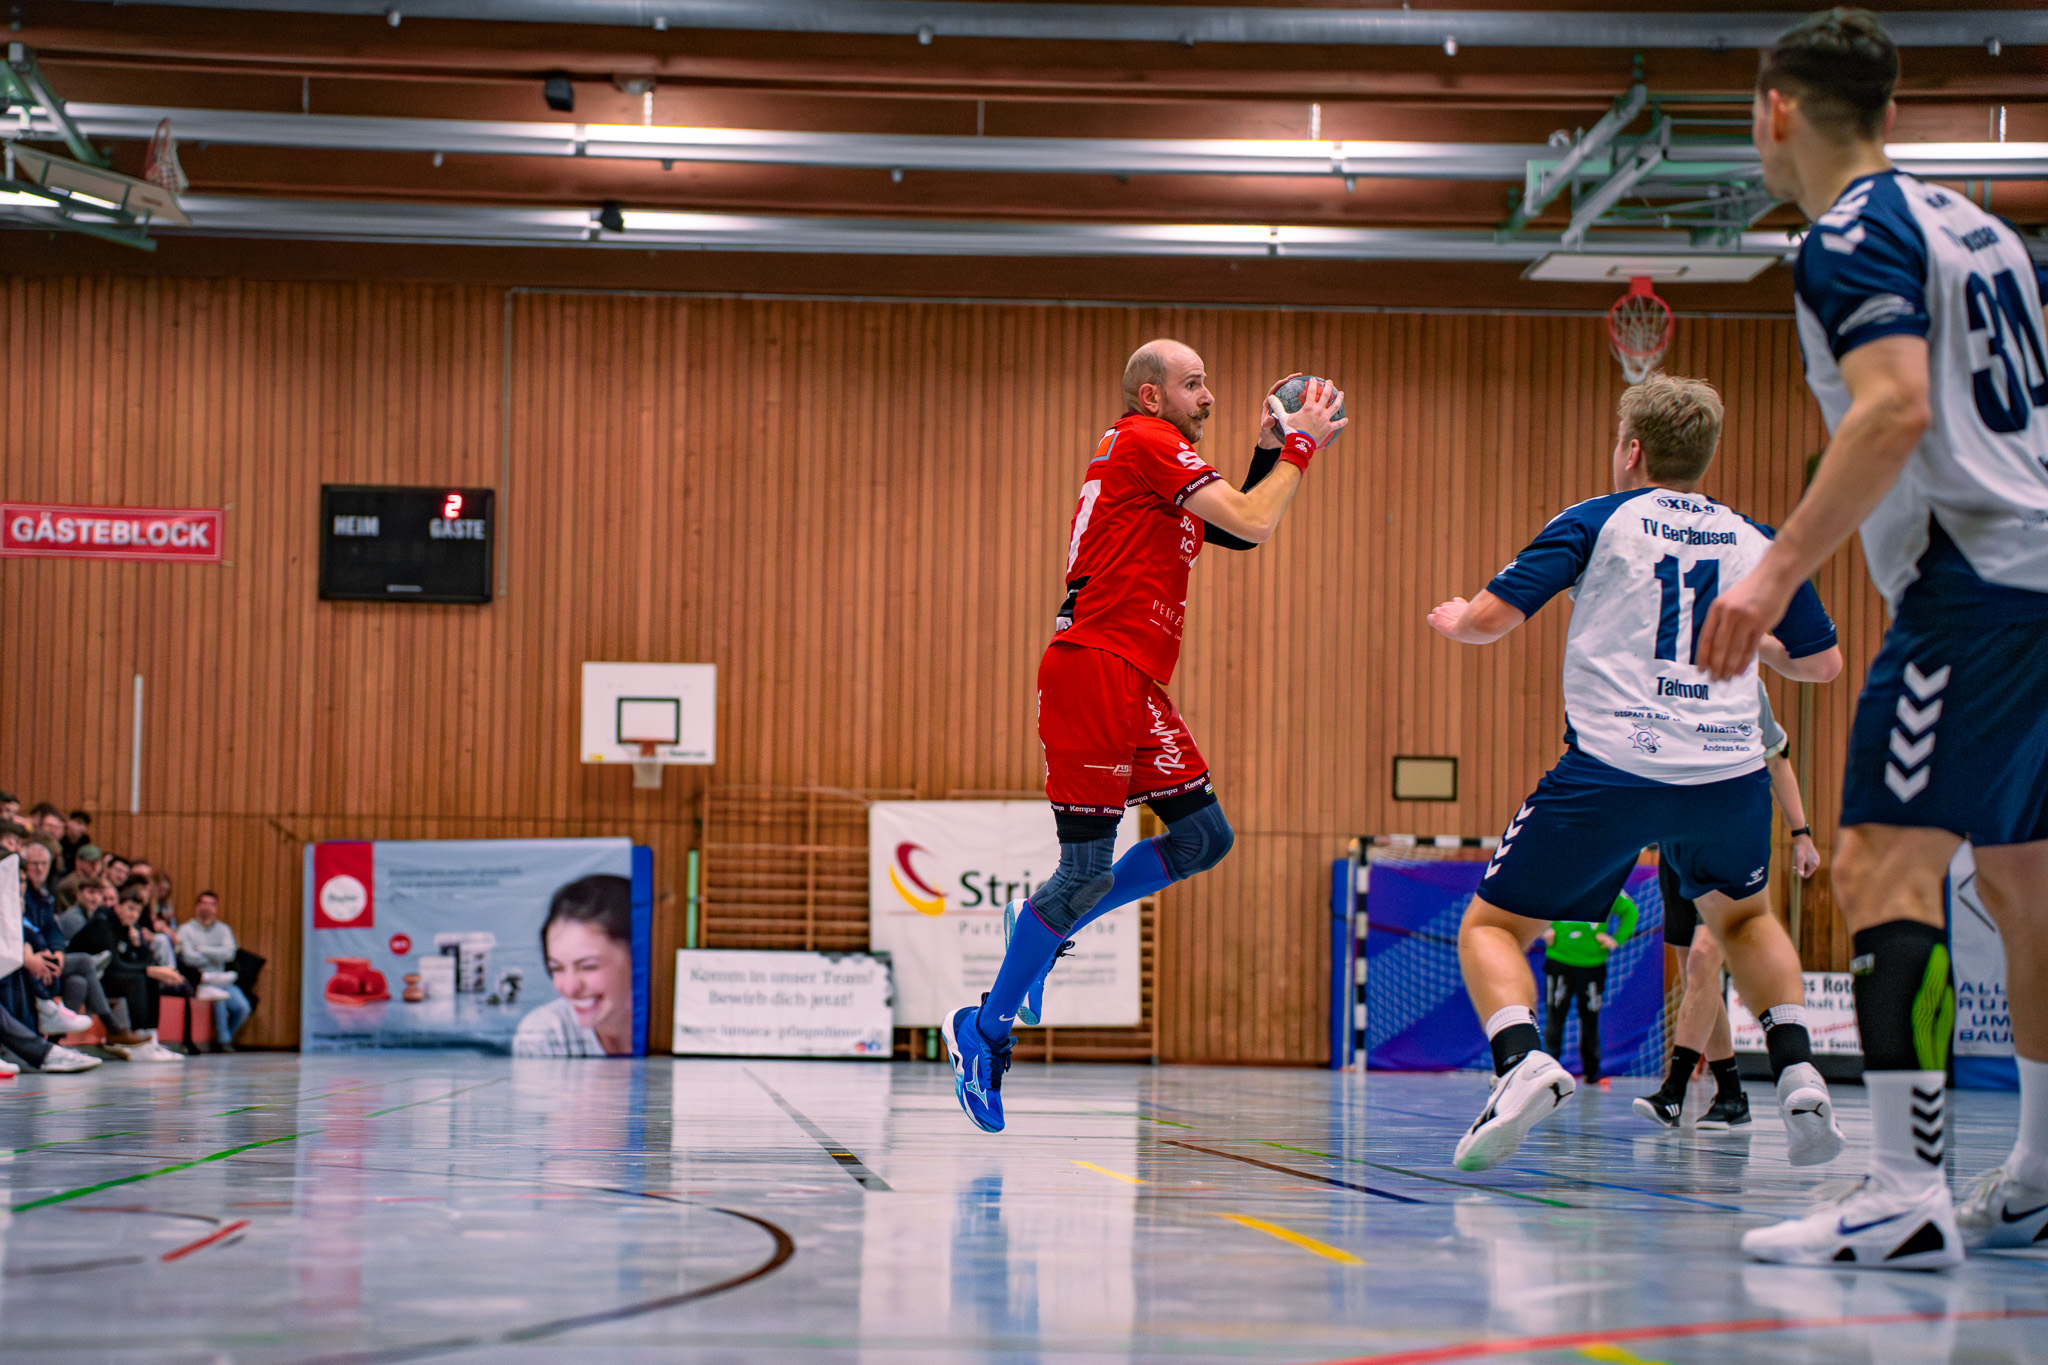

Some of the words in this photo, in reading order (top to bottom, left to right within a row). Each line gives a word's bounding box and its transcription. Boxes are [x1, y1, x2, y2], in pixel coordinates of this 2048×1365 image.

[1186, 475, 1209, 493] Kempa
[444, 494, 462, 518] 2
[11, 511, 209, 547] GÄSTEBLOCK
[334, 515, 380, 537] HEIM
[1641, 518, 1658, 537] TV
[1653, 553, 1720, 665] 11
[1656, 676, 1709, 700] Talmon
[1695, 722, 1738, 733] Allianz
[1151, 787, 1178, 799] Kempa
[1069, 805, 1096, 815] Kempa
